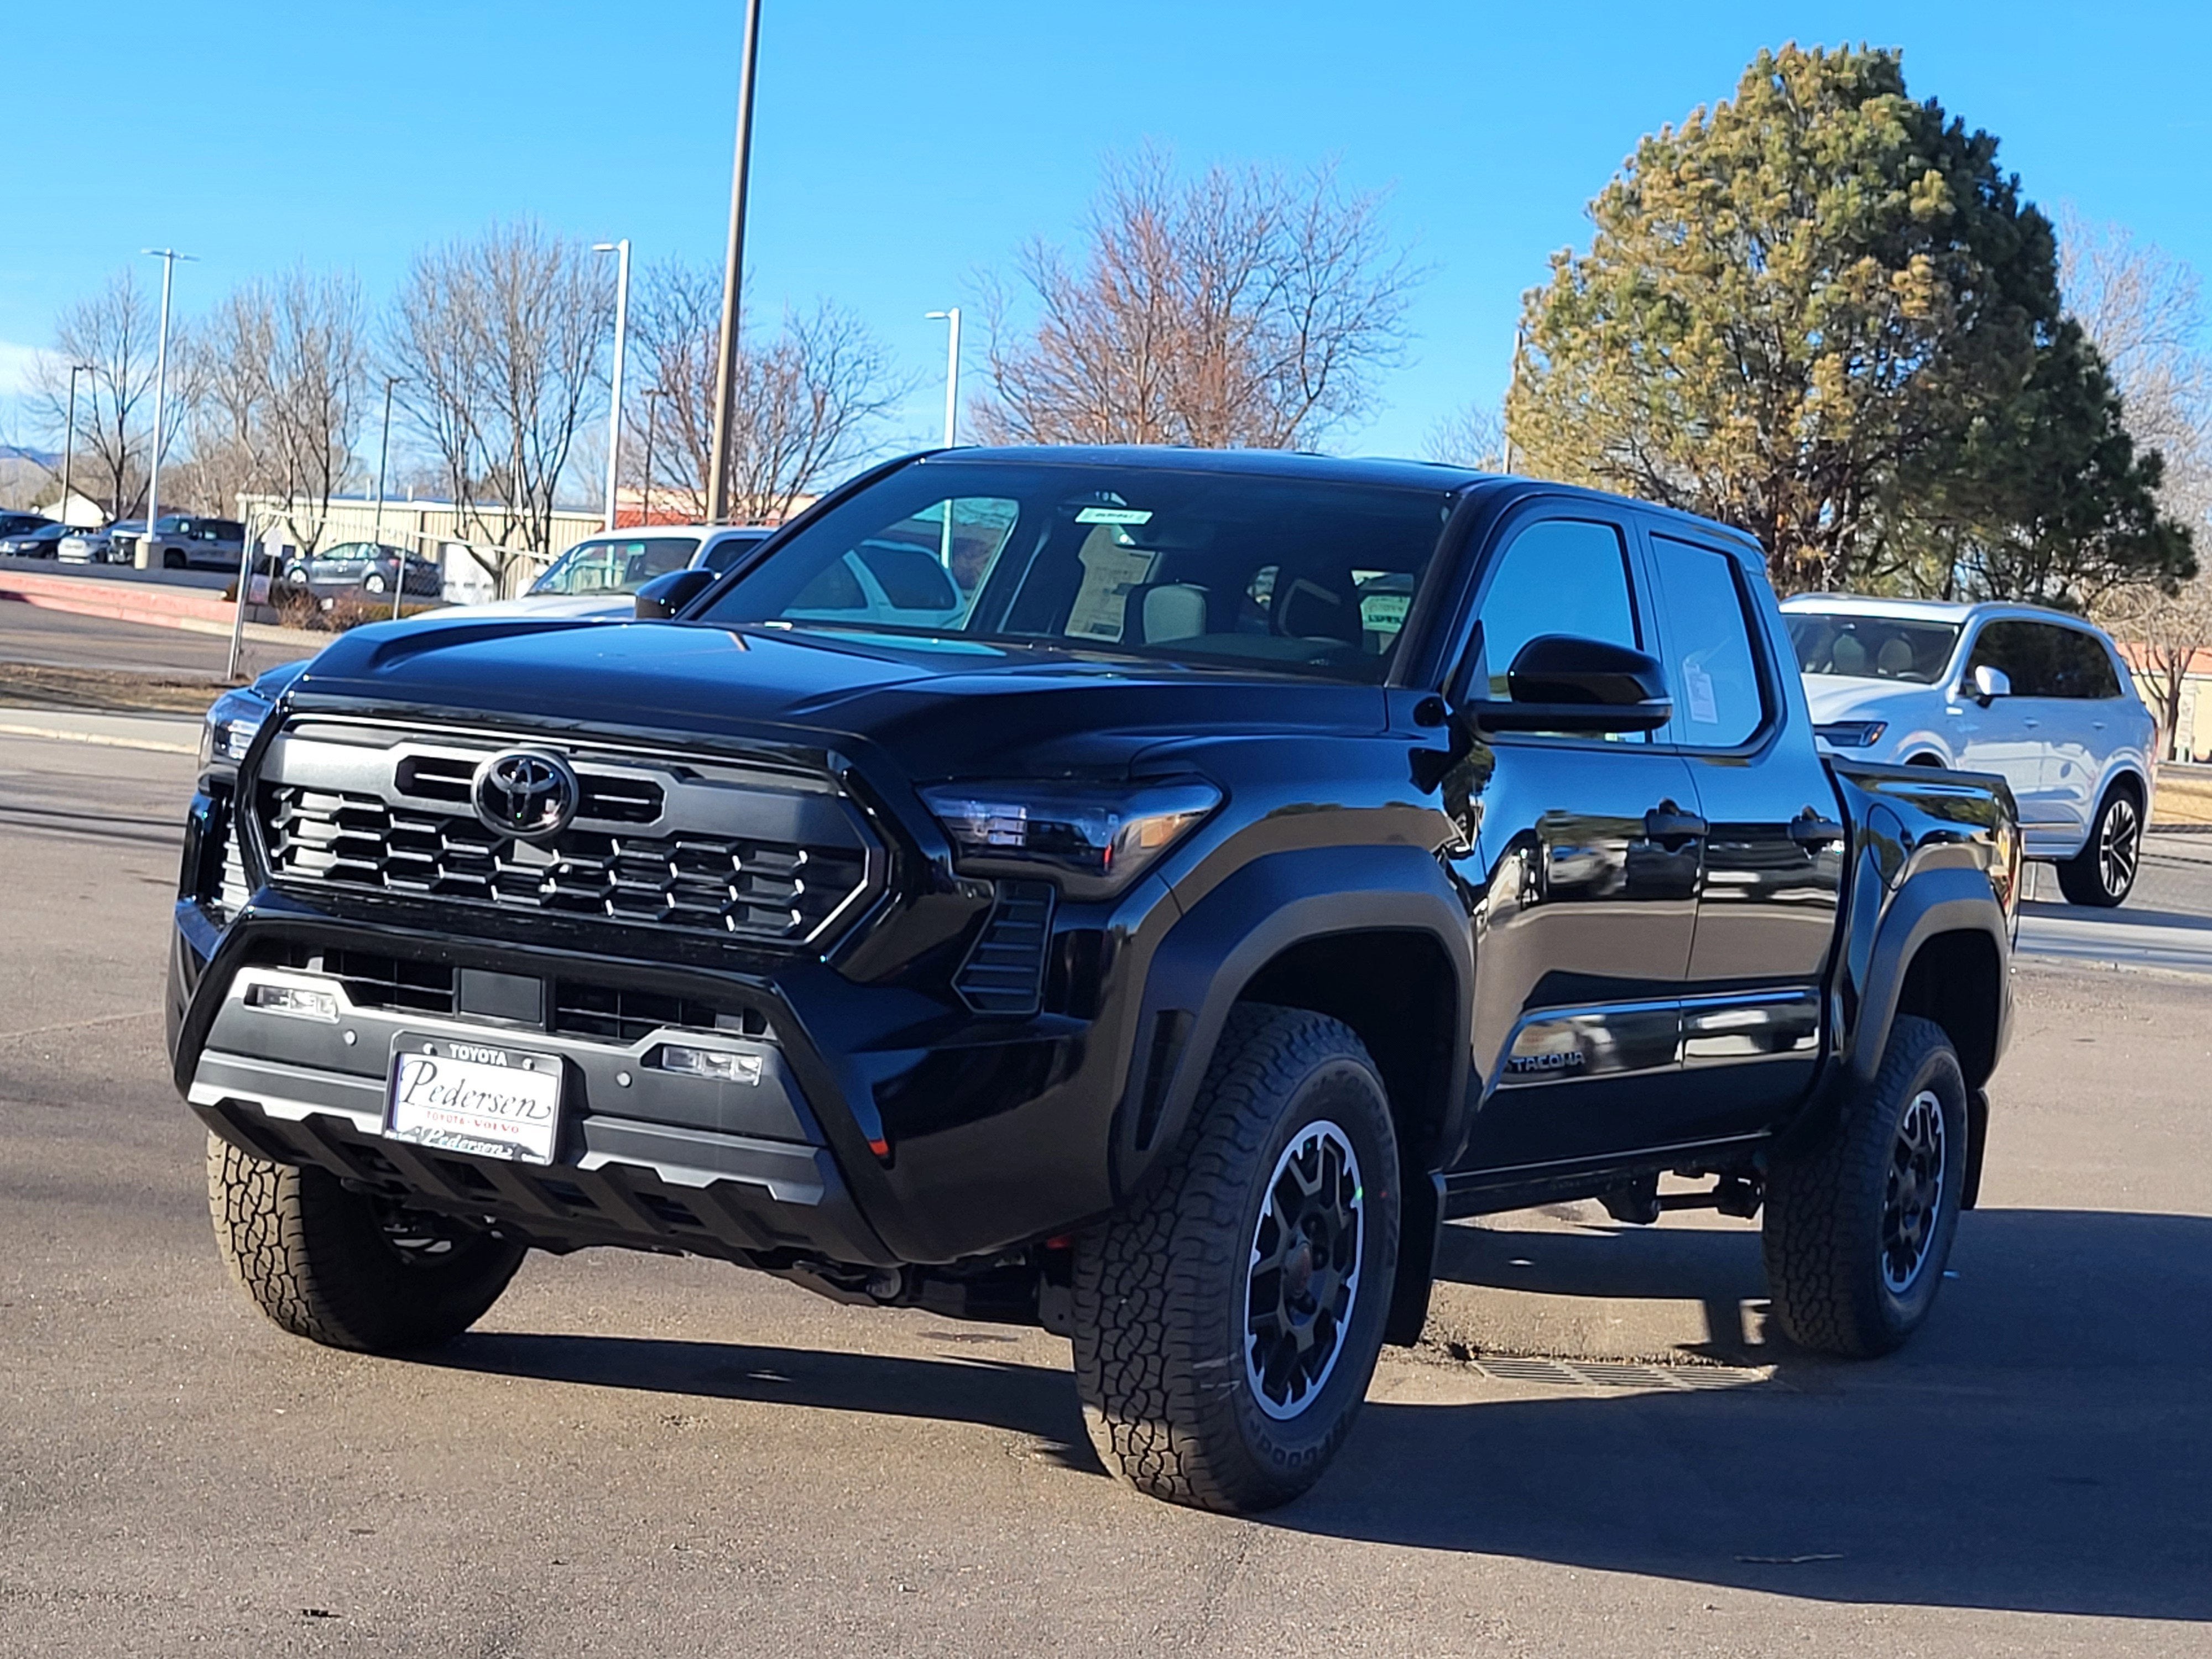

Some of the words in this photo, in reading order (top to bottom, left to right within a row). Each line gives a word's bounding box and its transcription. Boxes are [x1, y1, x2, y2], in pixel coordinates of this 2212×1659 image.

[448, 1043, 508, 1066] TOYOTA
[1512, 1052, 1585, 1072] TACOMA
[399, 1060, 552, 1119] Pedersen
[426, 1110, 465, 1125] TOYOTA
[419, 1126, 514, 1157] Pedersen
